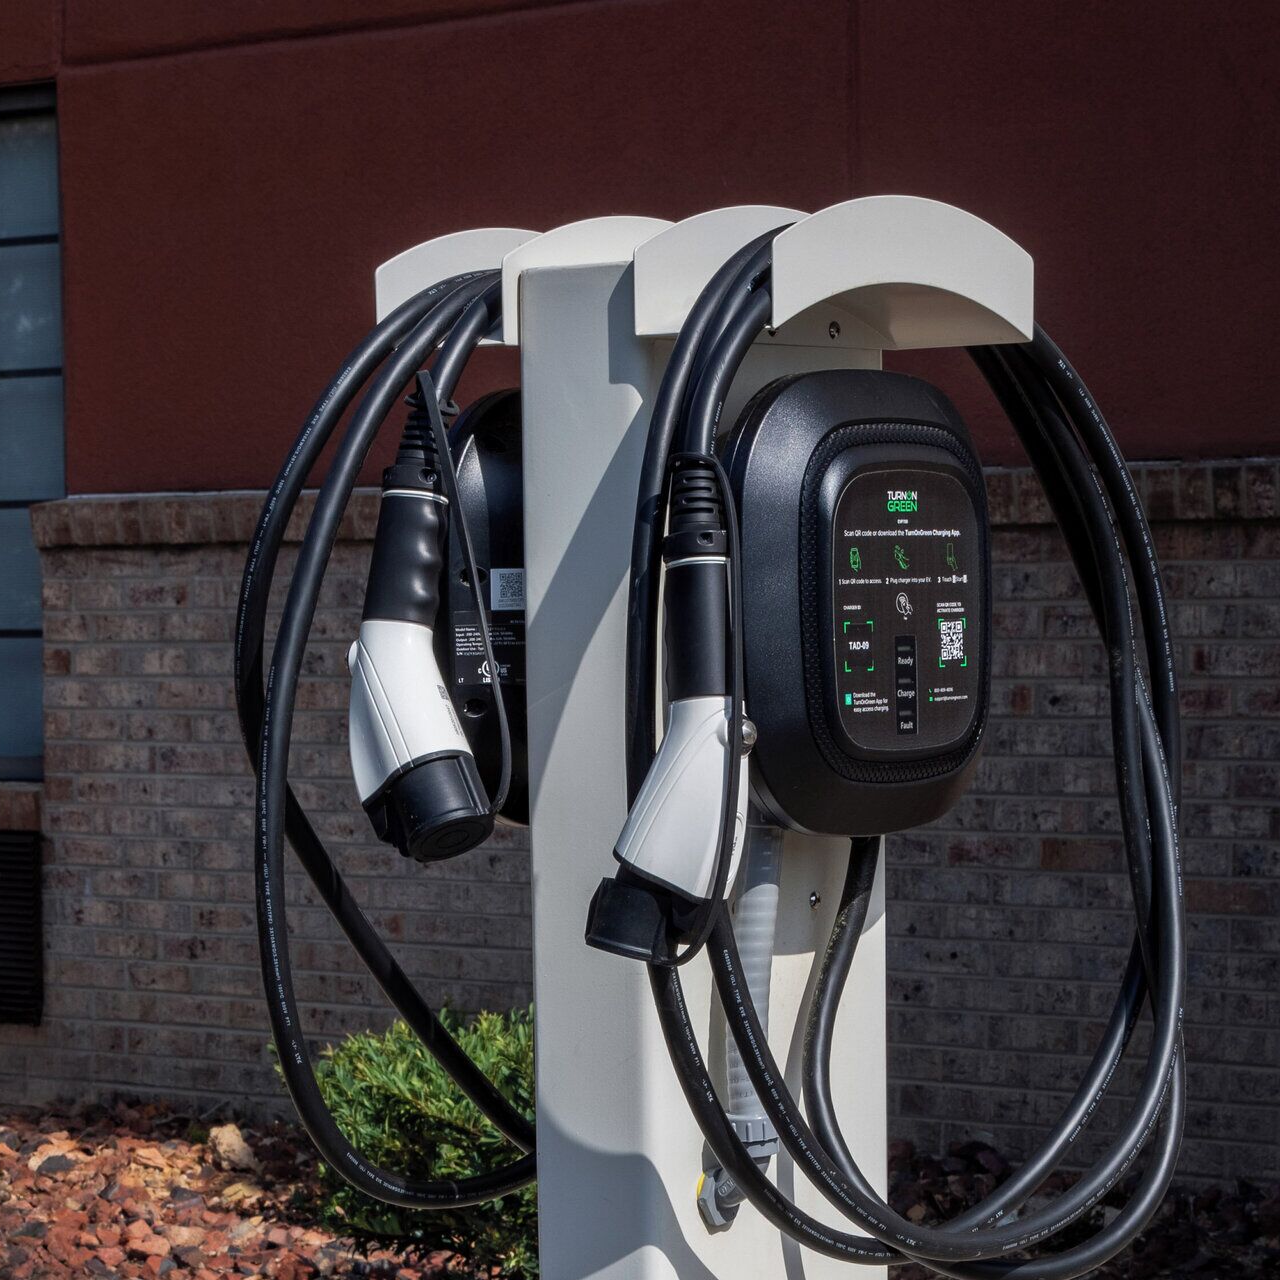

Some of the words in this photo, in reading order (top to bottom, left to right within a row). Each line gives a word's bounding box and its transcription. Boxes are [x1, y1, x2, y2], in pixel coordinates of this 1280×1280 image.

[887, 501, 918, 512] GREEN
[849, 641, 869, 650] TAD-09
[898, 657, 914, 666] Ready
[897, 690, 915, 698] Charge
[733, 989, 742, 1003] TYPE
[797, 1137, 807, 1149] TYPE
